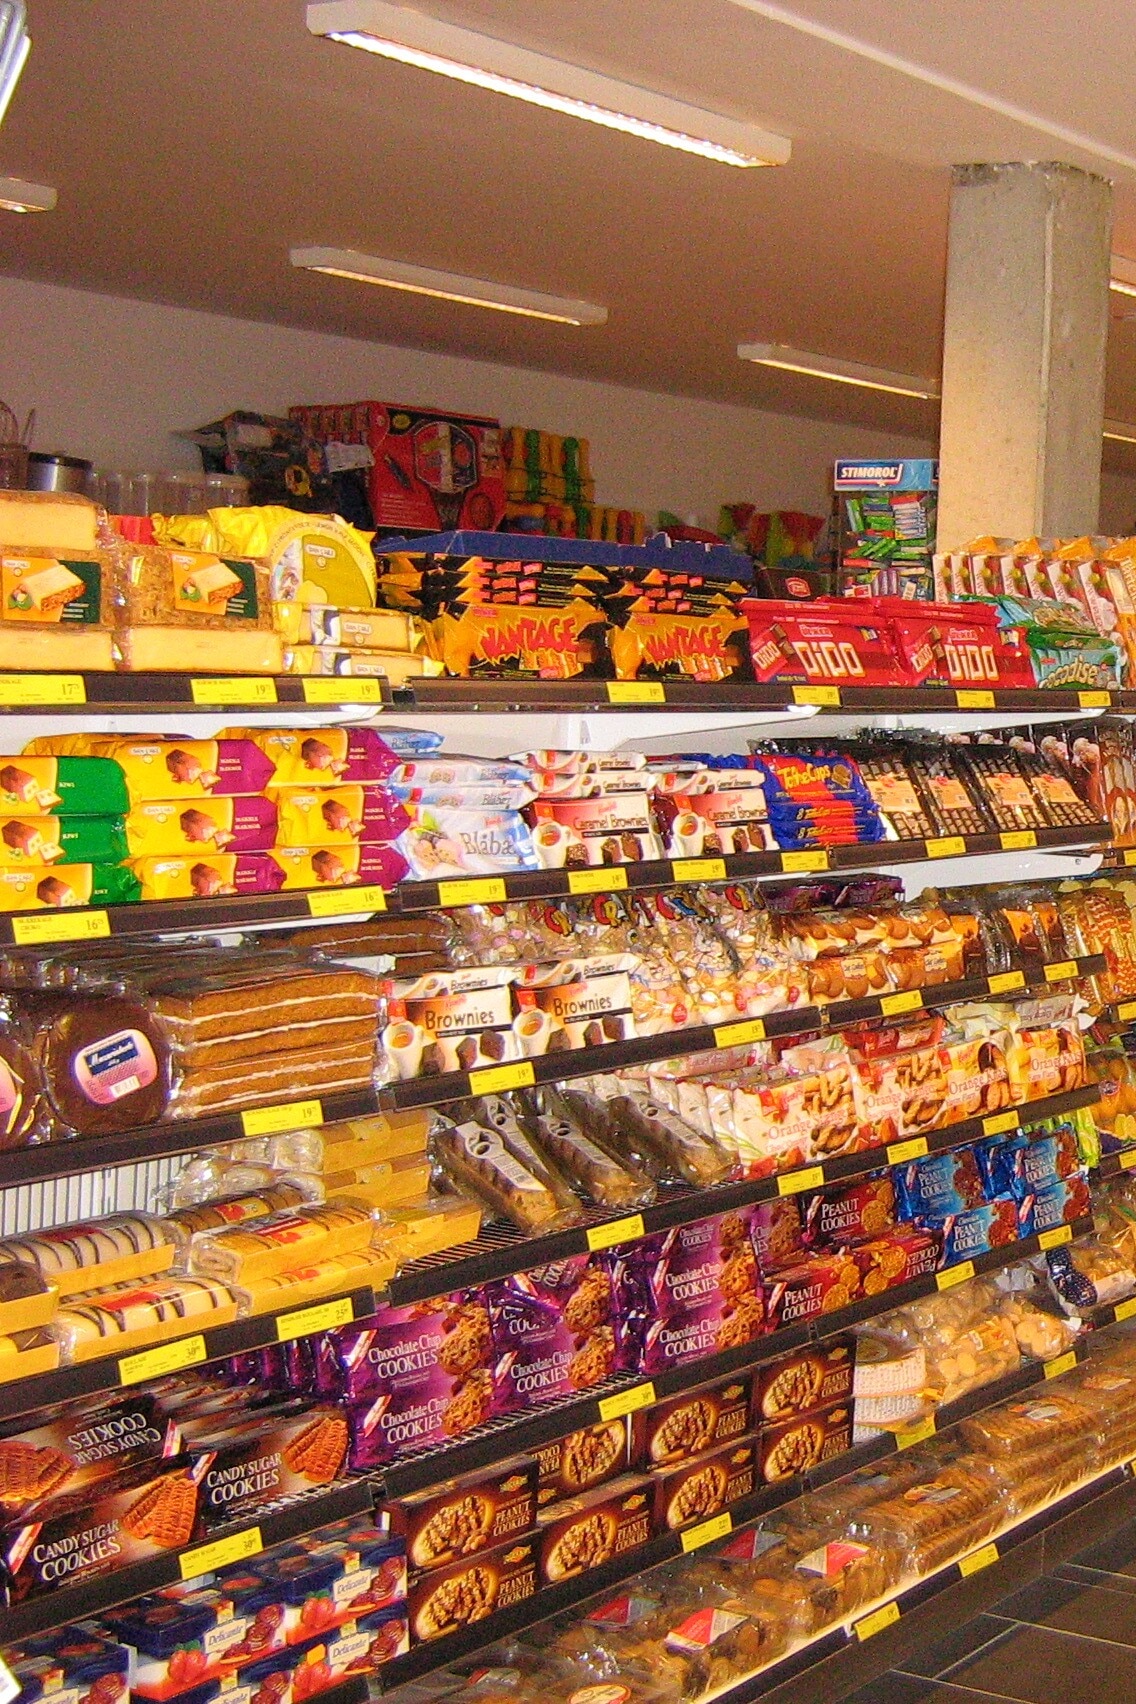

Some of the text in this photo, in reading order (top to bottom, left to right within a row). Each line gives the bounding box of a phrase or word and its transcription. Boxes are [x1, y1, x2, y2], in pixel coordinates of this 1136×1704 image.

[841, 466, 899, 478] STIMOROL
[573, 815, 649, 830] Caramel Brownies
[706, 806, 767, 822] Caramel Brownies
[451, 976, 488, 990] Brownies
[553, 993, 613, 1017] Brownies
[424, 1007, 495, 1031] Brownies
[949, 1073, 984, 1095] Orange
[767, 1119, 815, 1139] Orange
[821, 1198, 859, 1218] PEANUT
[821, 1211, 861, 1233] COOKIES
[954, 1220, 984, 1240] PEANUT
[682, 1232, 712, 1248] COOKIES
[665, 1262, 721, 1287] Chocolate Chip
[672, 1279, 720, 1301] COOKIES
[784, 1284, 823, 1305] PEANUT
[782, 1299, 822, 1322] COOKIES
[659, 1318, 721, 1344] Chocolate Chip
[368, 1333, 442, 1364] Chocolate Chip
[665, 1331, 716, 1358] COOKIES
[377, 1351, 439, 1380] COOKIES
[510, 1351, 574, 1380] Chocolate Chip
[516, 1364, 570, 1393] COOKIES
[380, 1397, 450, 1430] Chocolate Chip
[718, 1408, 747, 1428] PEANUT
[68, 1413, 148, 1451] COOKIES
[386, 1413, 443, 1445] COOKIES
[715, 1420, 747, 1439] COOKIES
[74, 1430, 162, 1465] CANDY SUGAR
[206, 1452, 283, 1488] CANDY SUGAR
[211, 1469, 280, 1506] COOKIES
[495, 1500, 531, 1523] PEANUT
[493, 1515, 531, 1537] COOKIES
[617, 1517, 650, 1539] PEANUT
[33, 1519, 121, 1563] CANDY SUGAR
[615, 1530, 649, 1553] COOKIES
[41, 1537, 121, 1581] COOKIES
[499, 1571, 536, 1595] PEANUT
[497, 1585, 536, 1608] COOKIES
